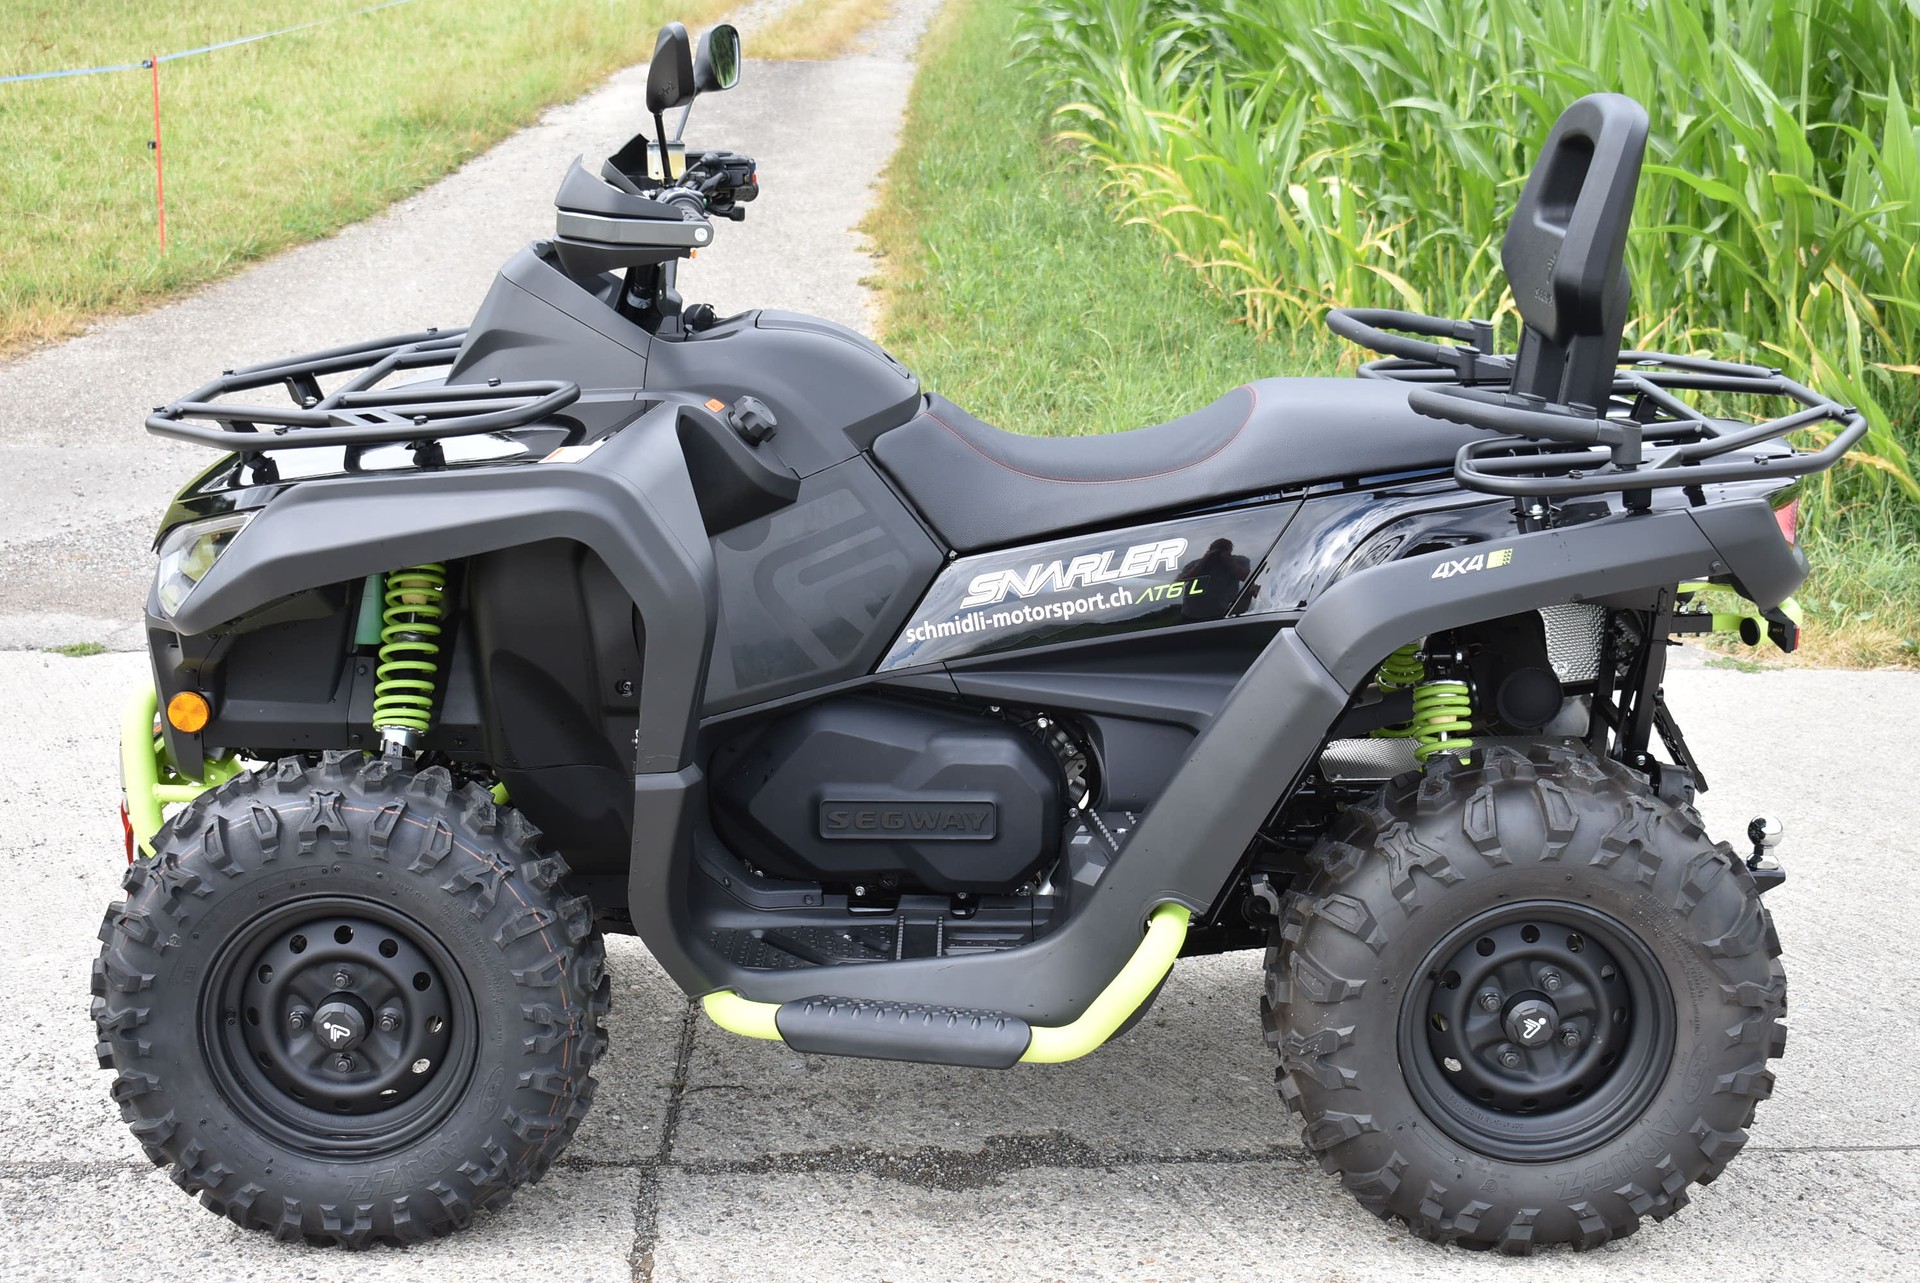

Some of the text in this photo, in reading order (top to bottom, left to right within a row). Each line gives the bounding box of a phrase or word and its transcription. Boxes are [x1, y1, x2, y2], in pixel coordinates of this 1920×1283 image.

[960, 538, 1188, 609] SNARLER
[1135, 579, 1204, 605] AT6 L
[907, 588, 1132, 643] schmidli-motorsport.ch
[827, 811, 989, 830] SEGWAY
[346, 1130, 466, 1201] ABUZZ
[1554, 1109, 1681, 1201] ABUZZ
